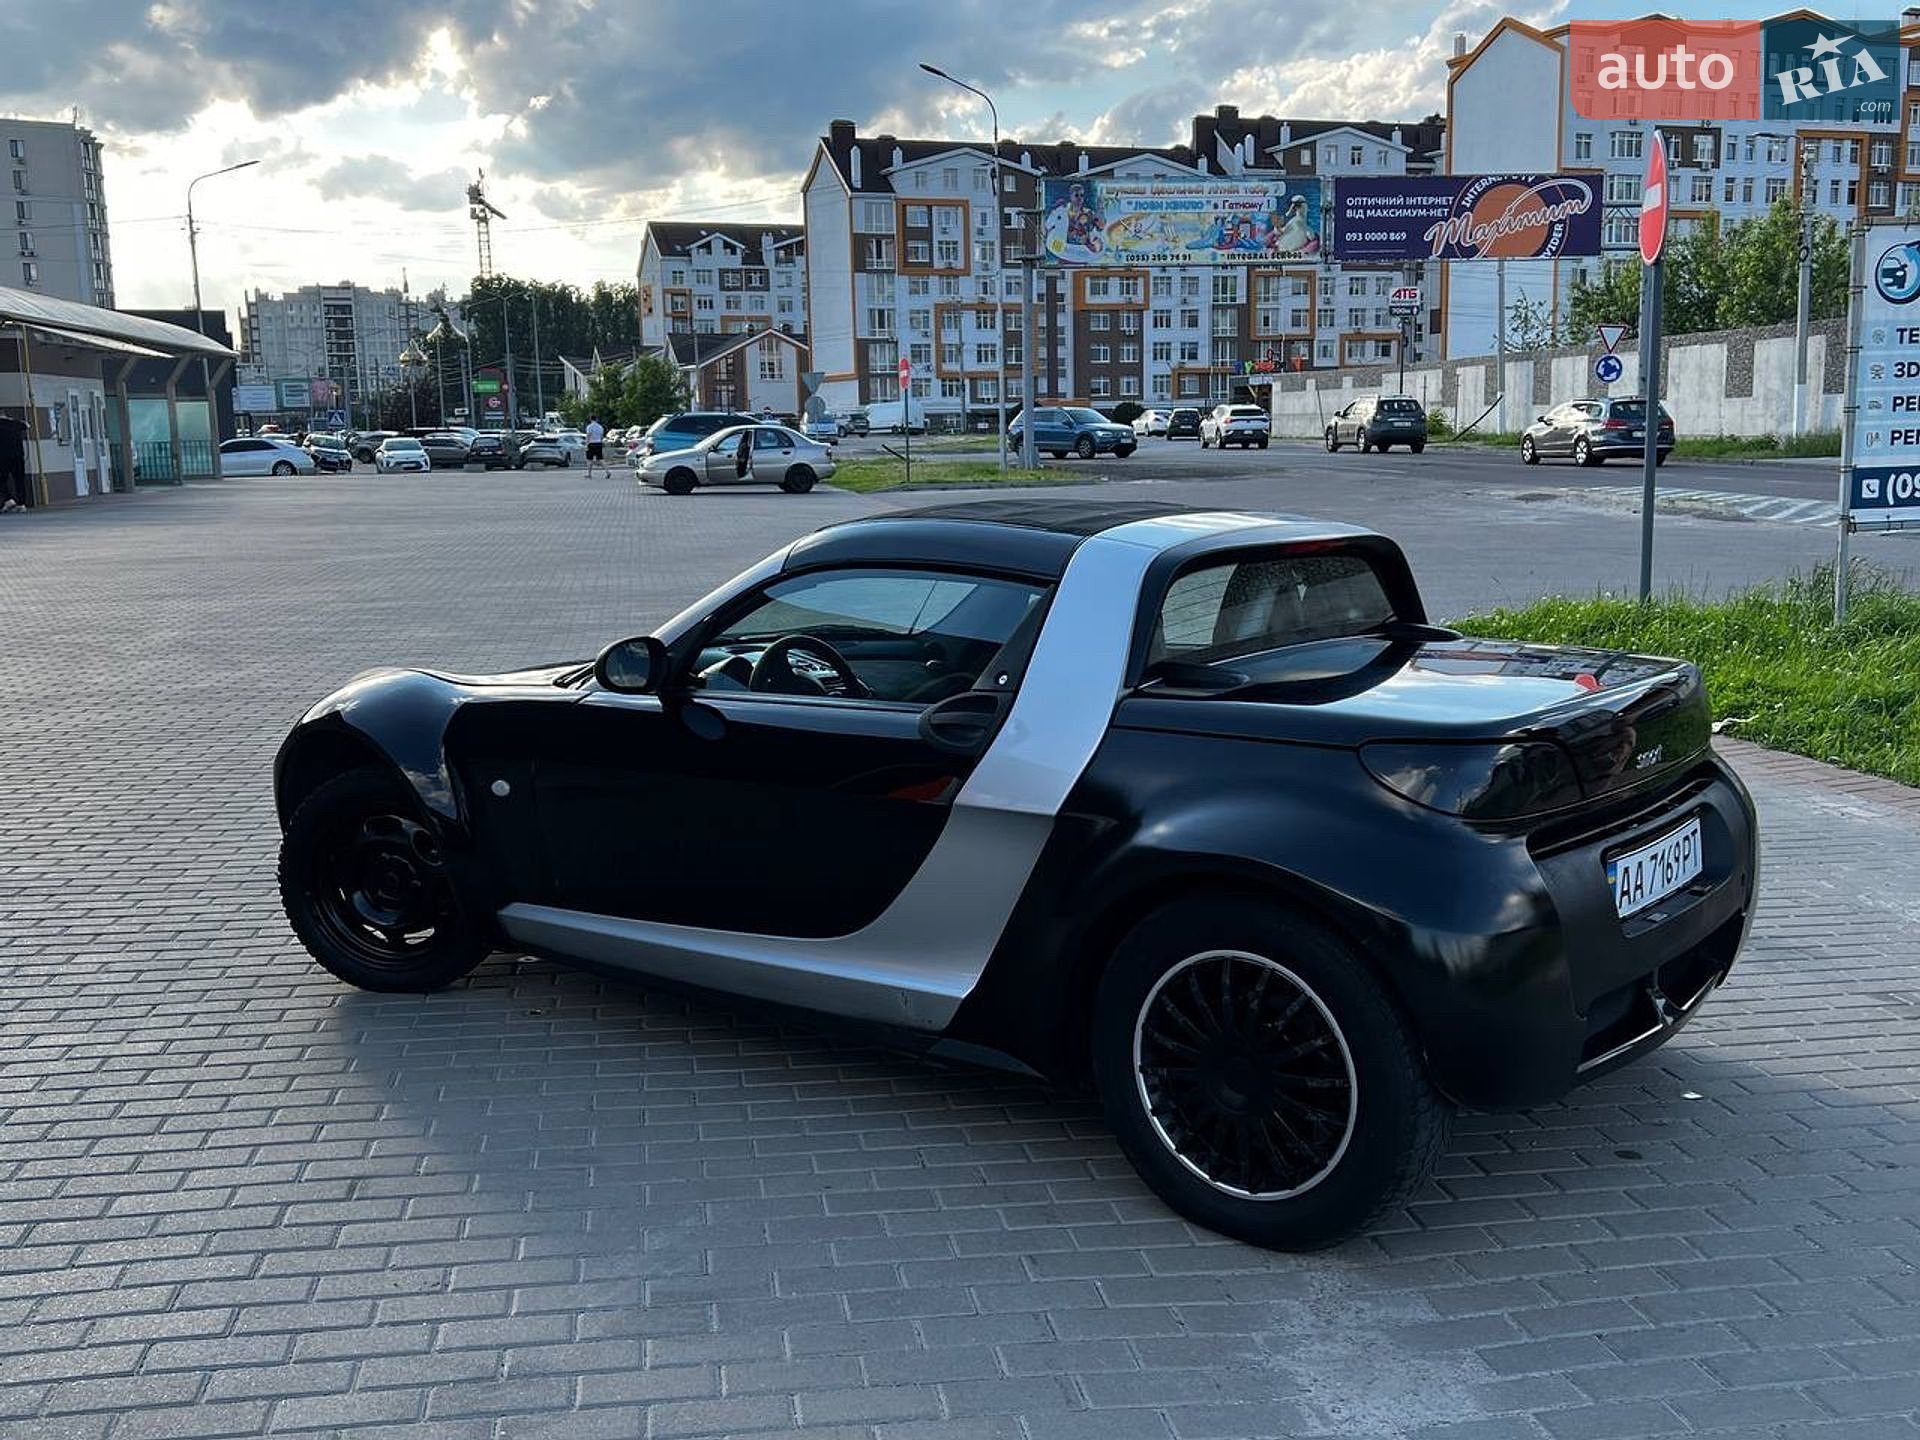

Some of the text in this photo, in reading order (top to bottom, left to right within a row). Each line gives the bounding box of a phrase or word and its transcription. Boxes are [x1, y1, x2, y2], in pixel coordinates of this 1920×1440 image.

[1346, 195, 1454, 206] ОПТИЧНИЙ ІНТЕРНЕТ
[1345, 208, 1364, 219] ВІД
[1345, 232, 1363, 242] 093
[1391, 287, 1418, 299] АТБ
[1891, 395, 1920, 412] РЕ
